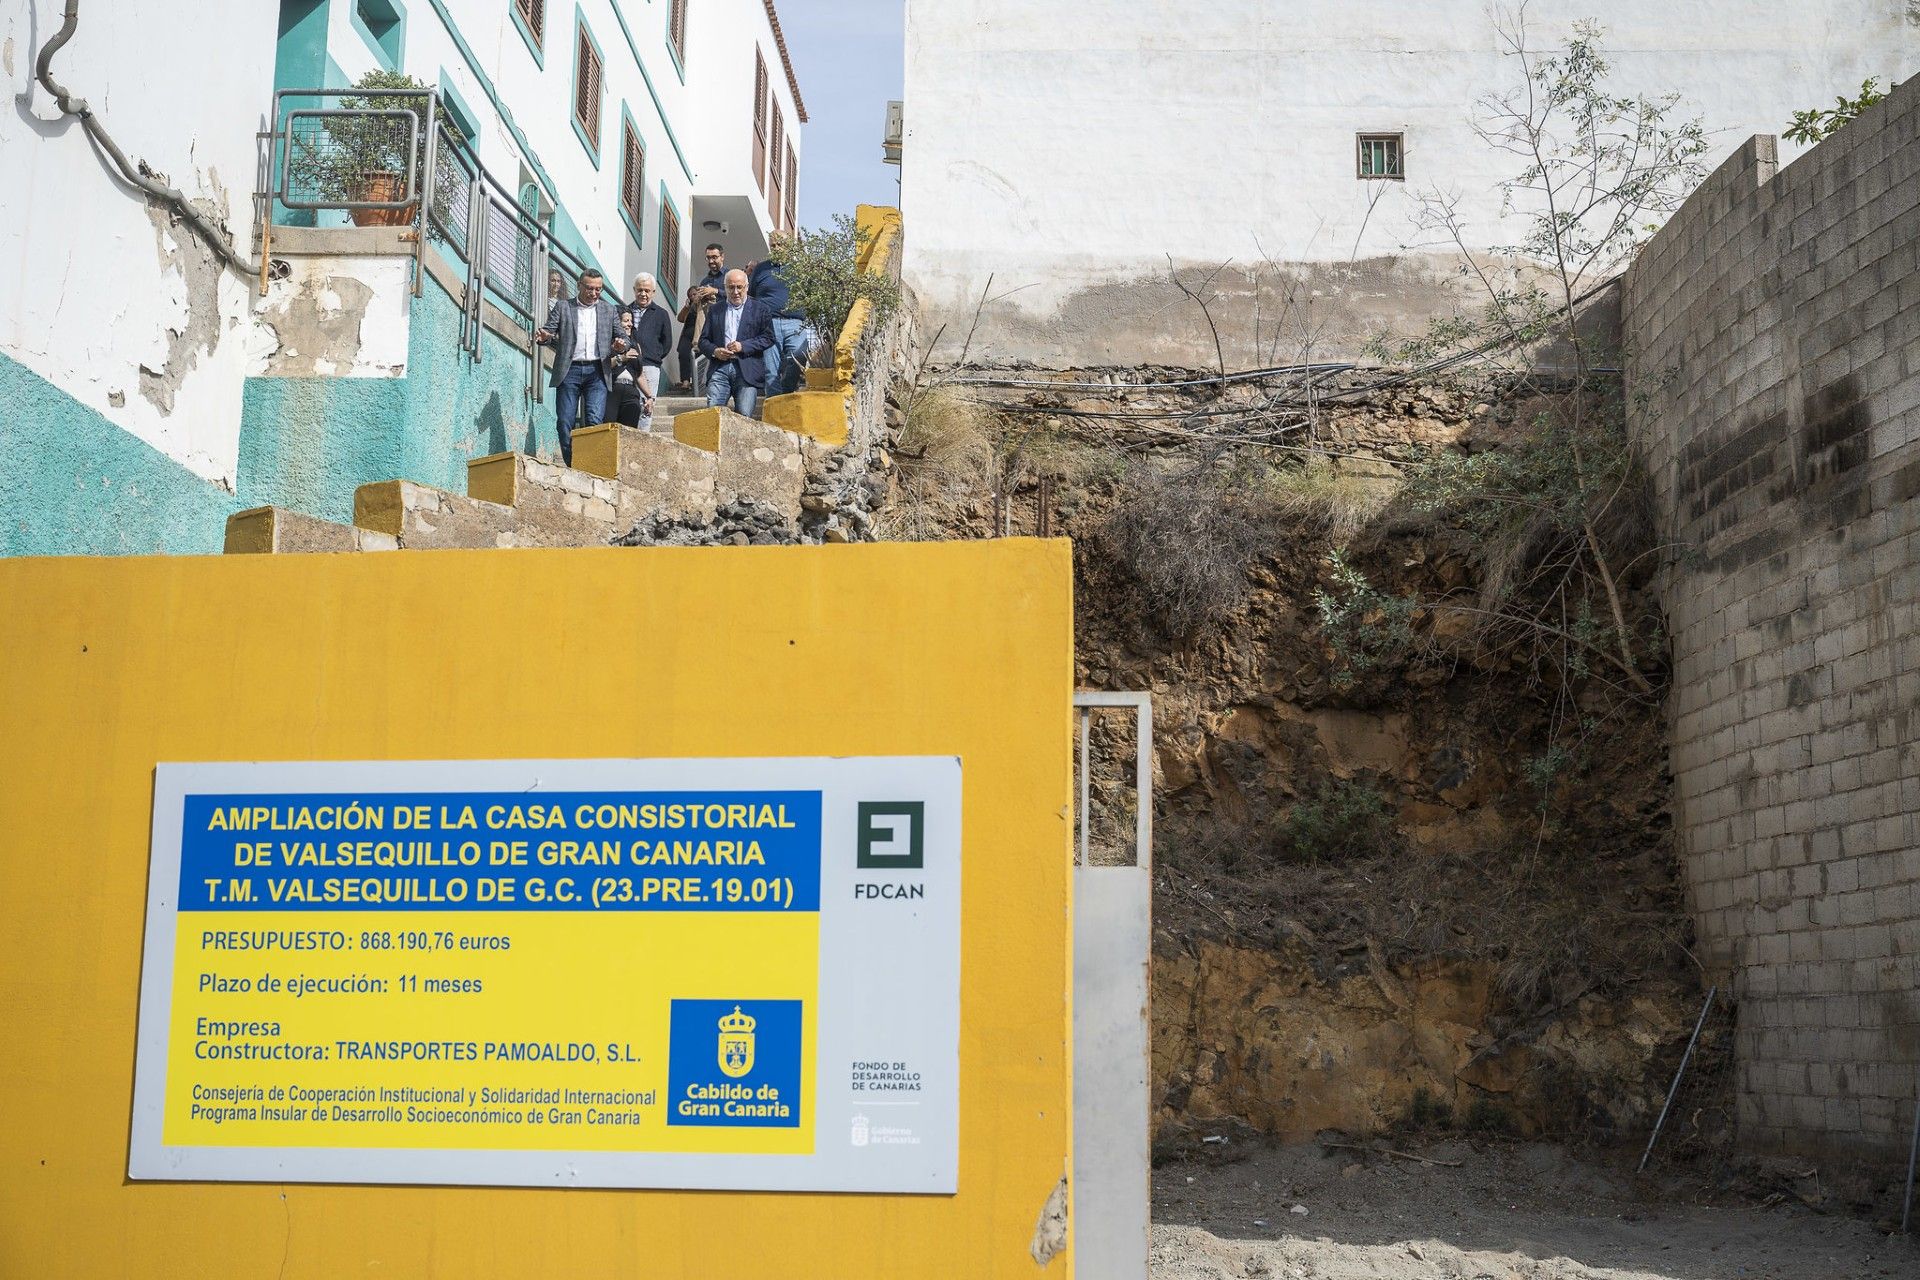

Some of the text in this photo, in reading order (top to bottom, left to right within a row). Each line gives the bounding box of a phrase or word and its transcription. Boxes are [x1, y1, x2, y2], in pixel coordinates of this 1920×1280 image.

[208, 802, 795, 831] AMPLIACIÓN DE LA CASA CONSISTORIAL
[235, 841, 764, 867] DE VALSEQUILLO DE GRAN CANARIA
[205, 878, 793, 908] T.M. VALSEQUILLO DE G.C. (23.PRE.19.01)
[855, 884, 923, 900] FDCAN
[203, 932, 510, 953] PRESUPUESTO: 868.190,76 euros
[200, 973, 482, 998] Plazo de ejecución: 11 meses
[197, 1017, 280, 1041] Empresa
[195, 1041, 640, 1064] Constructora: TRANSPORTES PAMOALDO, S.L.
[853, 1062, 905, 1071] FONDO DE
[853, 1072, 920, 1081] DESARROLLO
[193, 1084, 655, 1108] Consejería de Cooperación Institucional y Solidaridad Internacional
[687, 1084, 778, 1101] Cabildo de
[852, 1082, 921, 1091] DE CANARIAS
[192, 1105, 640, 1126] Programa Insular de Desarrollo Socioeconómico de Gran Canaria
[678, 1100, 789, 1118] Gran Canaria
